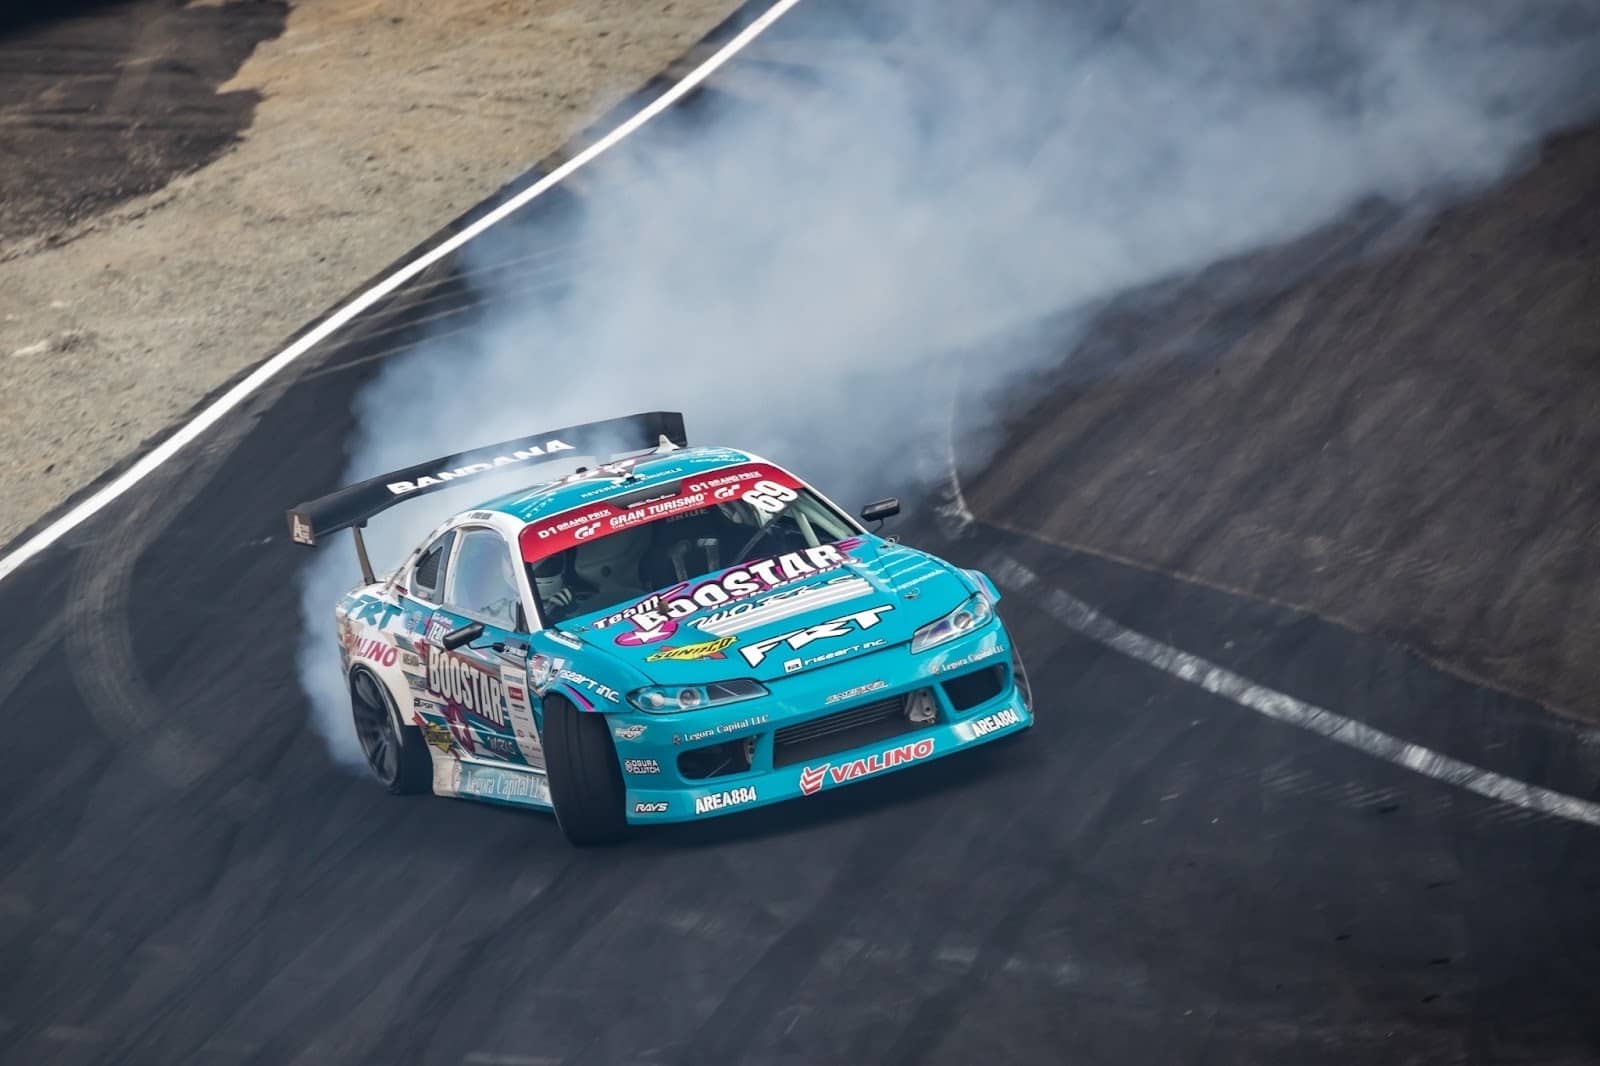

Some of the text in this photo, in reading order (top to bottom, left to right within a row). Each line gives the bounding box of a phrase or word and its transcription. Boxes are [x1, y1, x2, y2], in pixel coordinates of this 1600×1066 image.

[386, 439, 576, 495] BANDANA
[689, 482, 709, 493] D1
[538, 526, 558, 539] D1
[587, 508, 612, 521] PRIX
[610, 508, 645, 527] GRAN
[648, 493, 705, 515] TURISMO
[630, 544, 845, 632] BOOSTAR
[345, 593, 404, 630] FRT
[739, 604, 895, 668] FRT
[804, 644, 861, 666] riseart
[428, 643, 505, 726] BOOSTAR
[684, 714, 769, 743] Legora Capital LLC
[972, 708, 1021, 738] AREA884
[830, 738, 935, 783] VALINO
[635, 802, 669, 812] RAYS
[695, 786, 757, 815] AREA884
